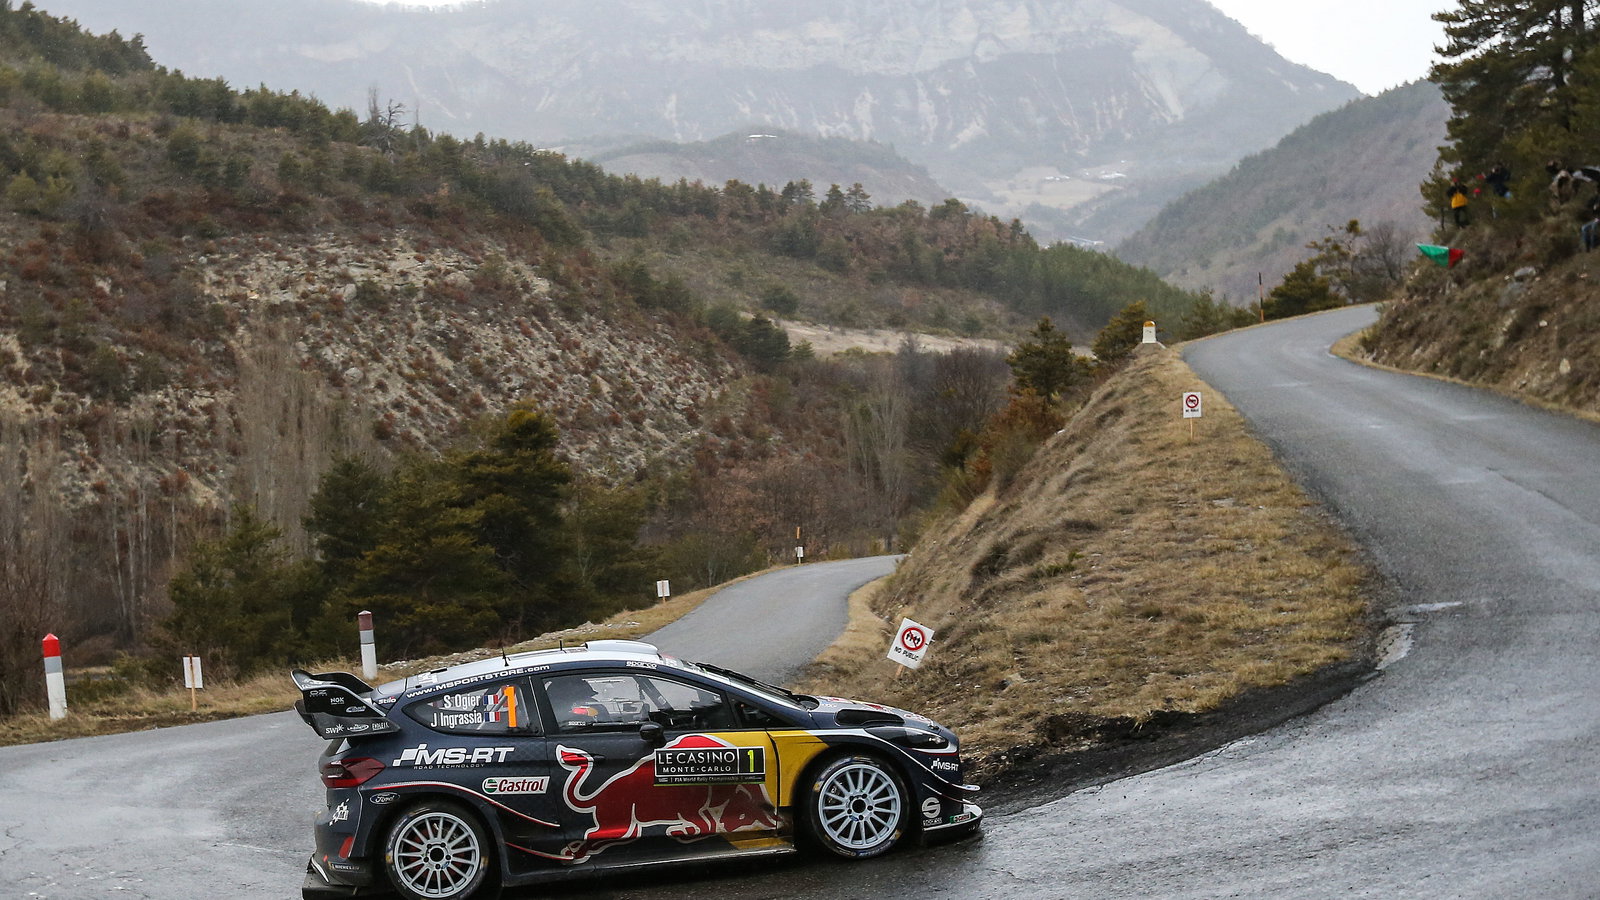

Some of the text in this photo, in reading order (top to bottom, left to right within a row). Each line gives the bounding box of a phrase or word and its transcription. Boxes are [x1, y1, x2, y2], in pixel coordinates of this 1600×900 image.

[894, 646, 919, 661] NO PUBLIC
[444, 694, 481, 710] S Ogier
[504, 686, 517, 728] 1
[431, 709, 482, 728] J Ingrassia
[414, 747, 514, 765] MS-RT
[658, 751, 736, 765] LE CASINO
[747, 750, 755, 773] 1
[498, 779, 544, 792] Castrol
